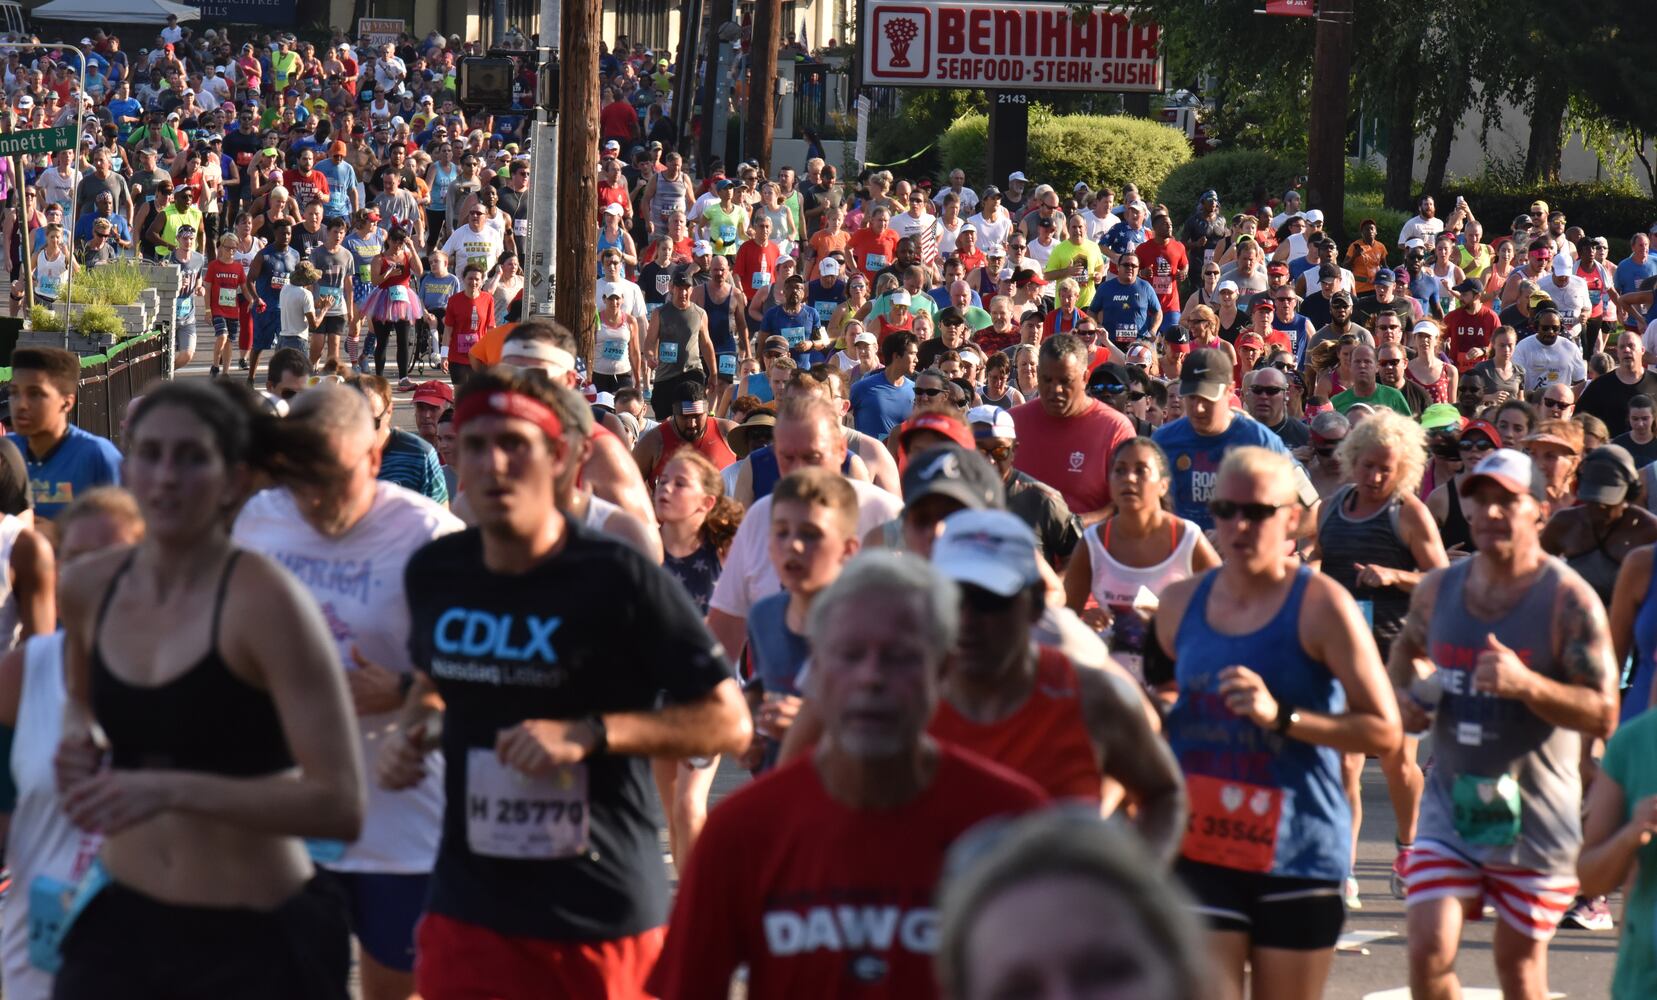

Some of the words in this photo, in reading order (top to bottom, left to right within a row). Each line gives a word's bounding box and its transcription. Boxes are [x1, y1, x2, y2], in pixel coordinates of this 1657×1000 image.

[938, 8, 1159, 59] BENIHANA
[937, 58, 1023, 81] SEAFOOD
[1033, 61, 1092, 83] STEAK
[1102, 63, 1158, 85] SUSHI
[998, 94, 1027, 104] 2143
[0, 132, 46, 153] nnett
[55, 128, 66, 137] ST
[56, 138, 68, 148] NW
[656, 275, 671, 284] USA
[1457, 327, 1485, 336] USA
[433, 607, 562, 663] CDLX
[469, 797, 489, 822] H
[495, 799, 585, 825] 25770
[1204, 815, 1275, 847] 35544
